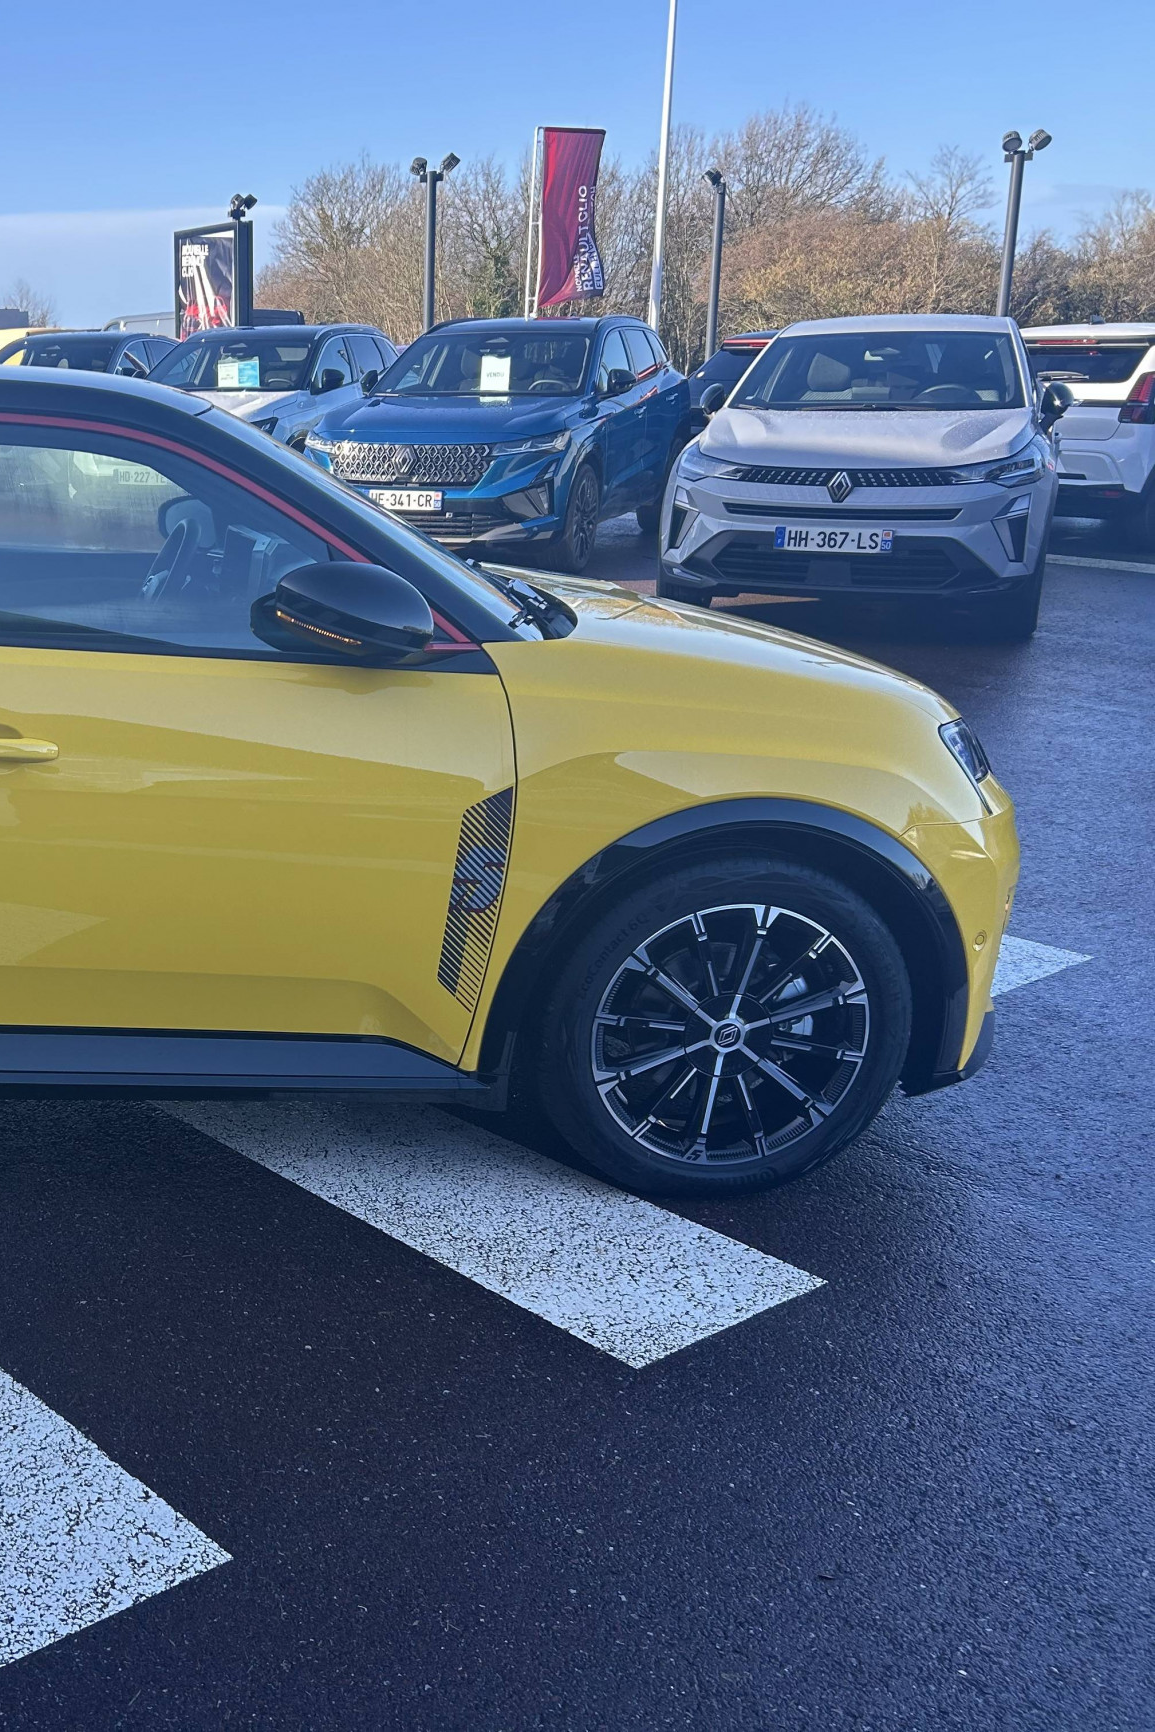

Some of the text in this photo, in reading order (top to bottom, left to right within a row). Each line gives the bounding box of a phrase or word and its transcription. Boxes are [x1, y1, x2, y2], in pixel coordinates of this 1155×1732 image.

[578, 185, 588, 223] CLIO
[787, 530, 879, 550] HH-367-LS
[881, 541, 892, 550] 50
